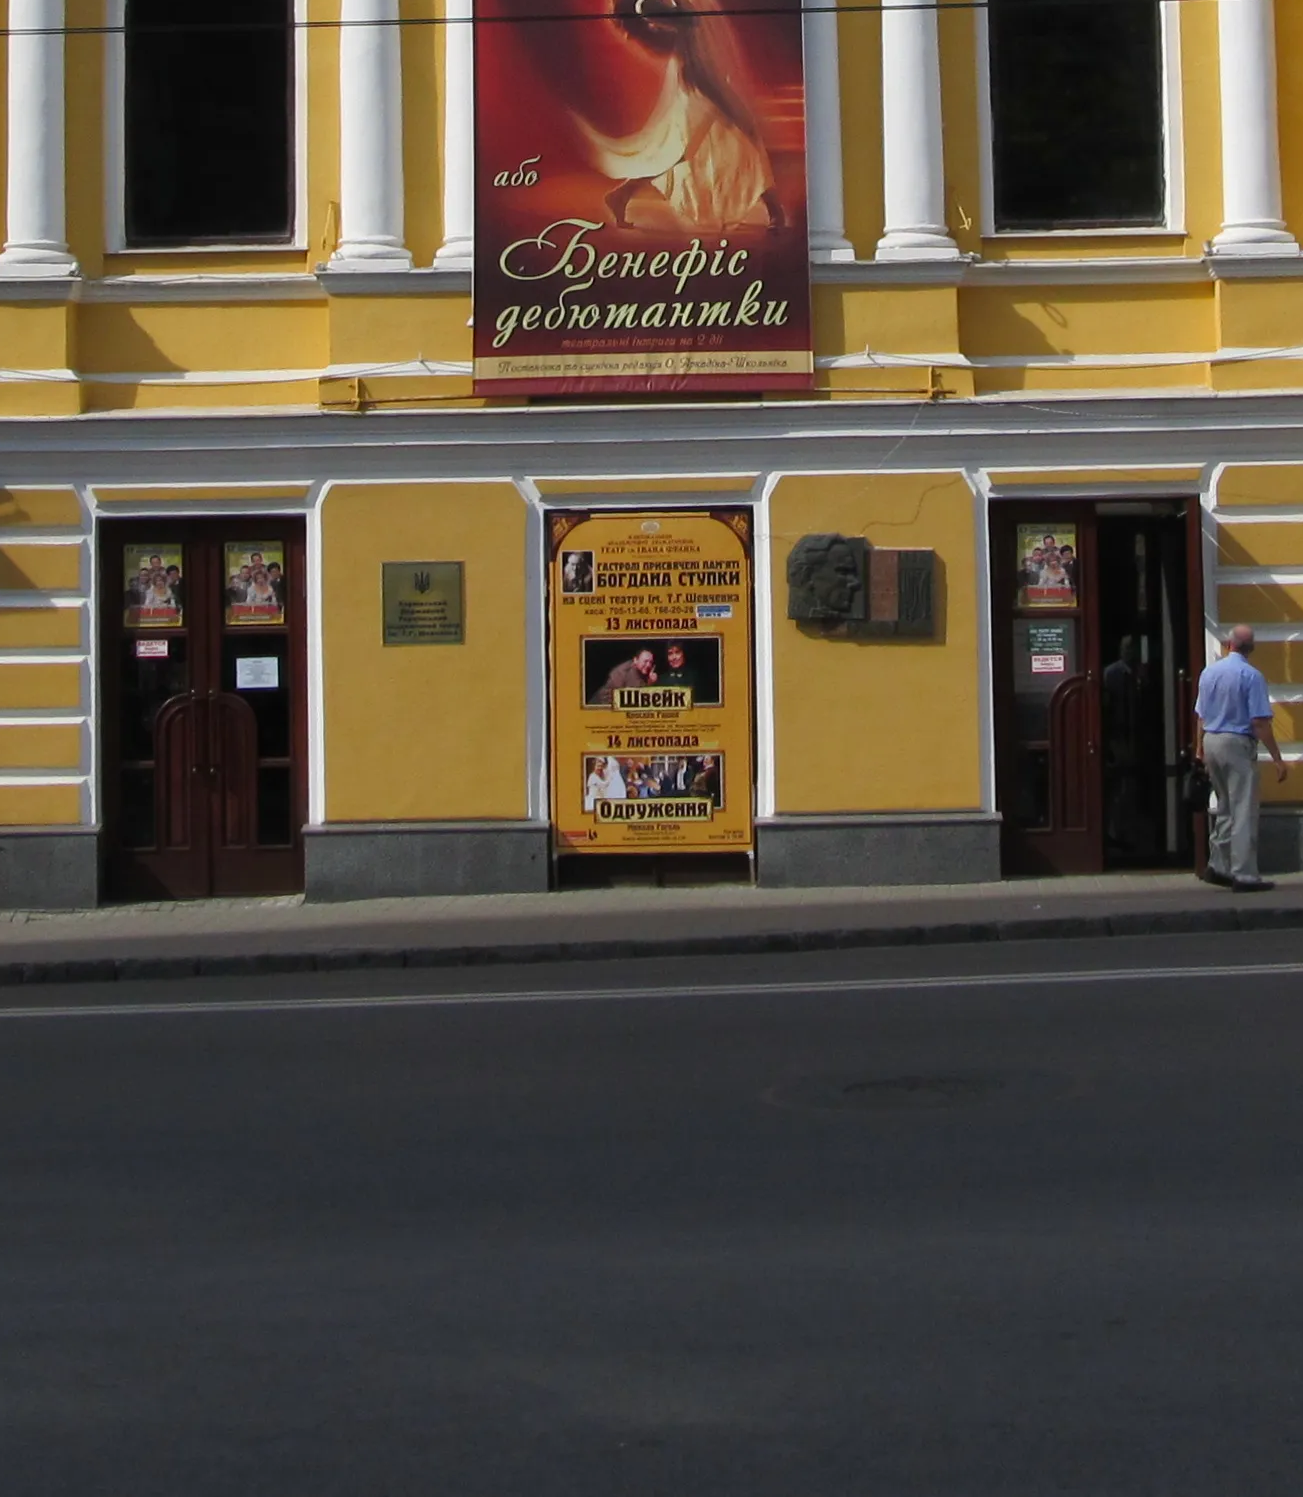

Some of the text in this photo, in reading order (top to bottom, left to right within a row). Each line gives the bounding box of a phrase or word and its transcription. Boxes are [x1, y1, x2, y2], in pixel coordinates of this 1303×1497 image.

[493, 155, 542, 187] або
[499, 218, 748, 295] Бенефіс
[492, 277, 788, 348] дебютантки
[597, 560, 740, 571] ГАСТРОЛІ ПРИСВЯЧЕНІ ПАМ'ЯТІ
[597, 571, 740, 588] БОГДАНА СТУПКИ
[563, 596, 575, 605] на
[579, 595, 605, 605] сцені
[609, 595, 644, 605] театру
[606, 617, 698, 631] 13 листопада
[619, 690, 686, 708] Швейк
[607, 735, 699, 748] 14 листопада
[600, 801, 709, 819] Одруження
